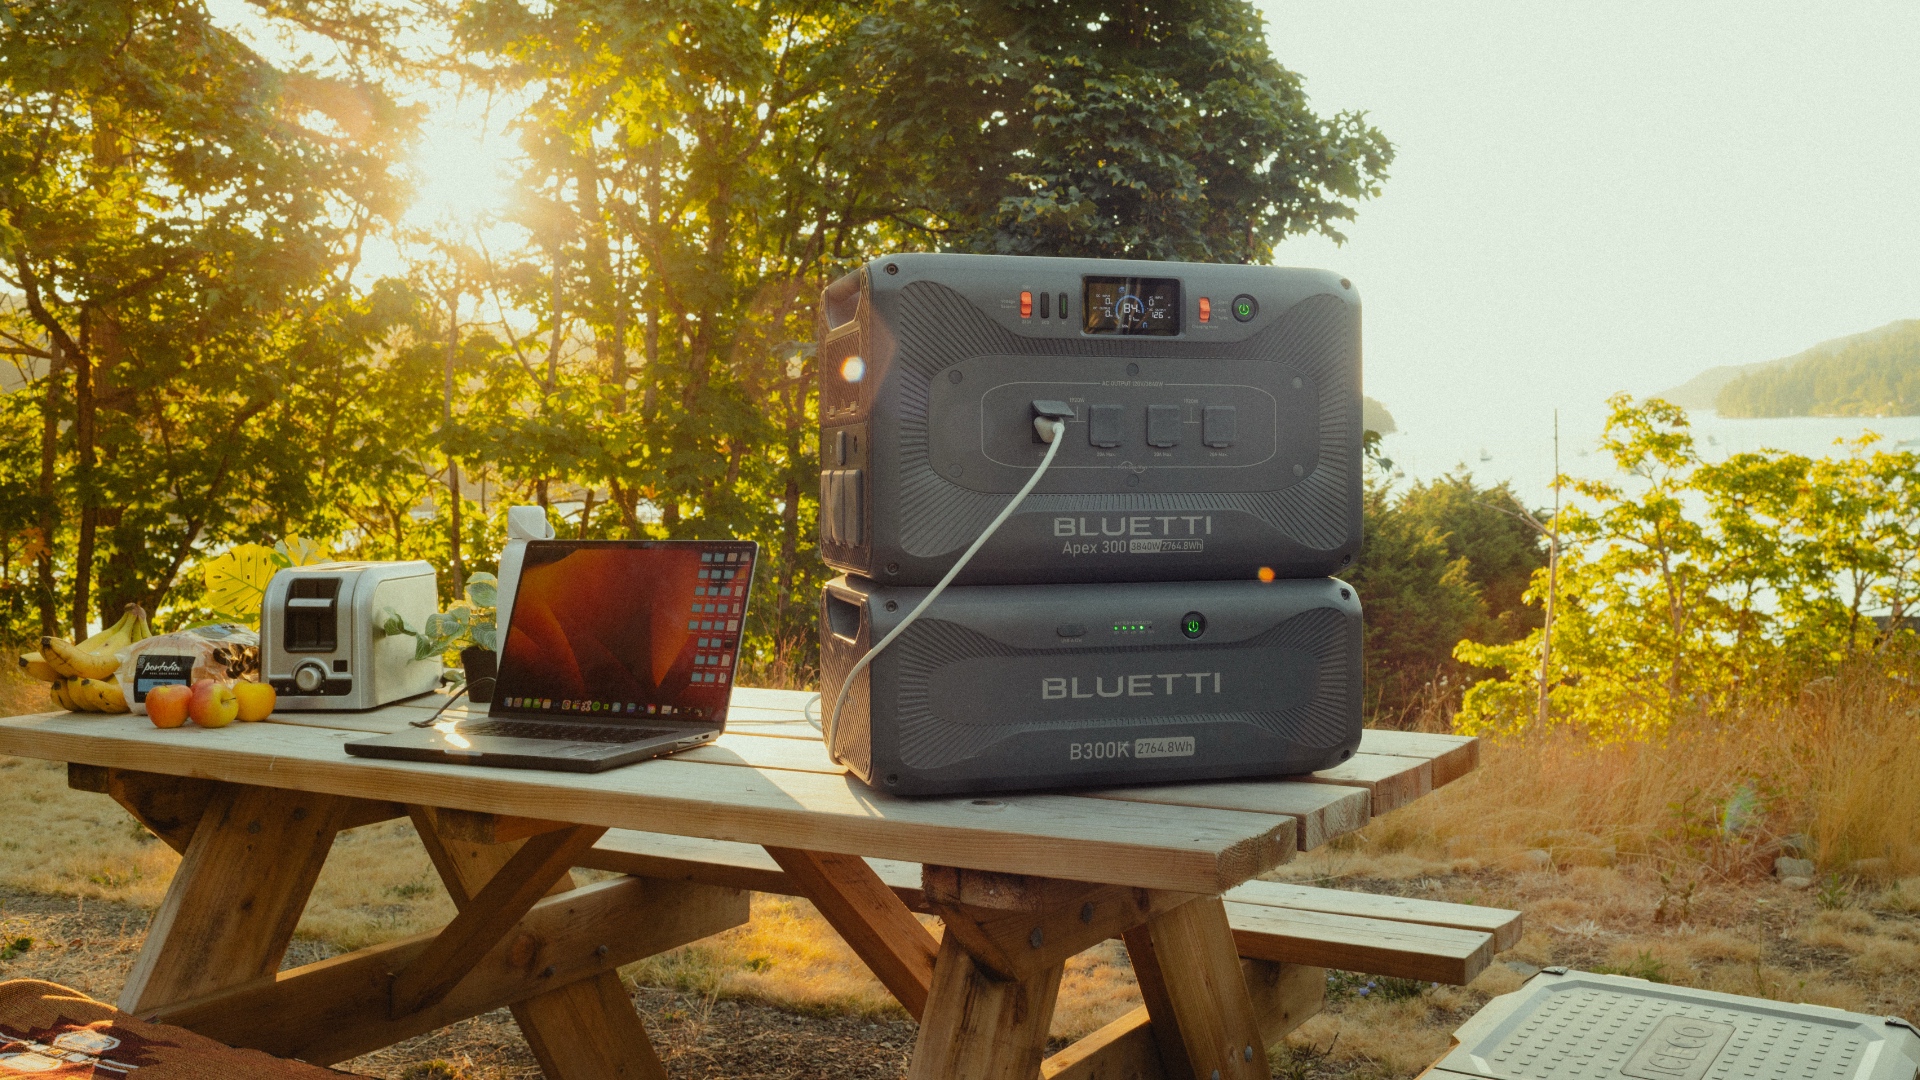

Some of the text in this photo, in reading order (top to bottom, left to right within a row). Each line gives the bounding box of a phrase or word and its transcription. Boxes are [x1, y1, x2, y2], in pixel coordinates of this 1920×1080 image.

[1053, 515, 1212, 537] BLUETTI
[1062, 540, 1203, 557] Apex 300 3840W 2764.8Wh
[1042, 672, 1221, 700] BLUETTI
[1070, 740, 1193, 760] B300K 2764.8Wh
[1640, 1025, 1715, 1078] ICECO
